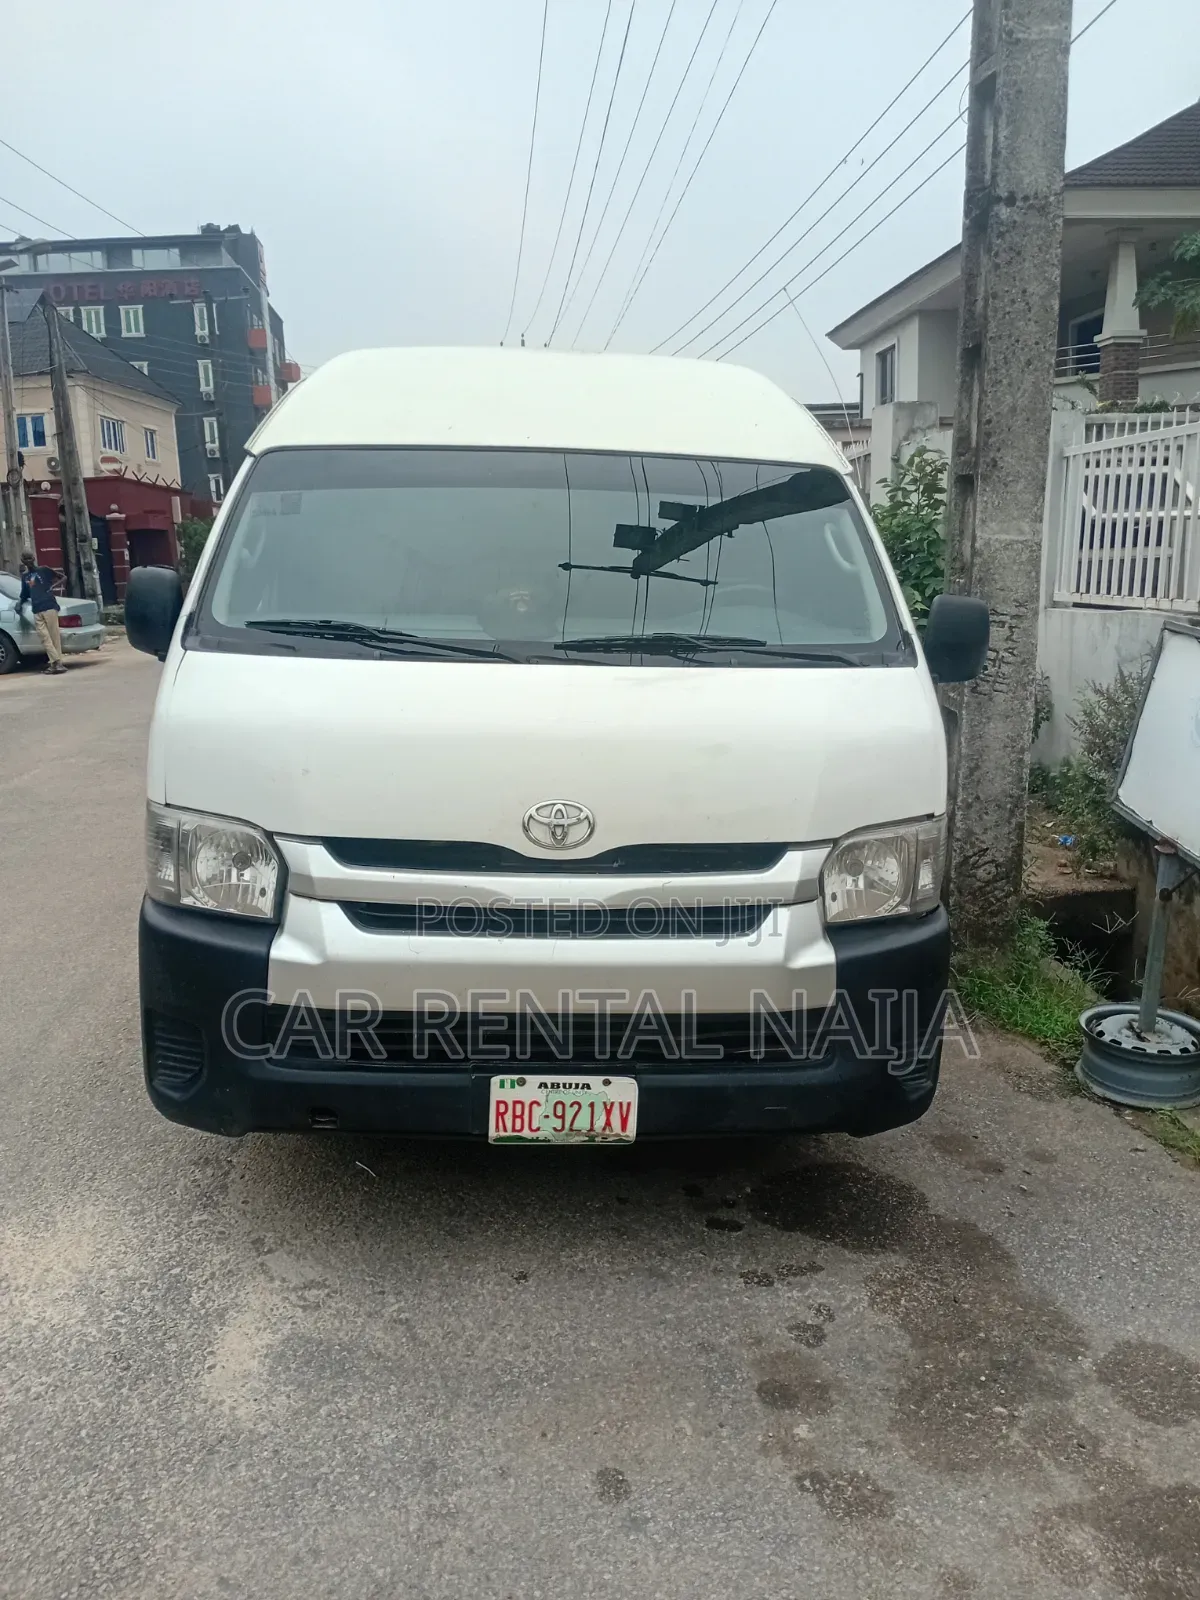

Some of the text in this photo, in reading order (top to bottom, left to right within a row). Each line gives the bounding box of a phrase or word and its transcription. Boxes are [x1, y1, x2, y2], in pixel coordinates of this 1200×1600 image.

[44, 280, 113, 302] OTEL
[537, 1082, 592, 1090] ABUJA
[495, 1100, 631, 1133] RBC-921XV
